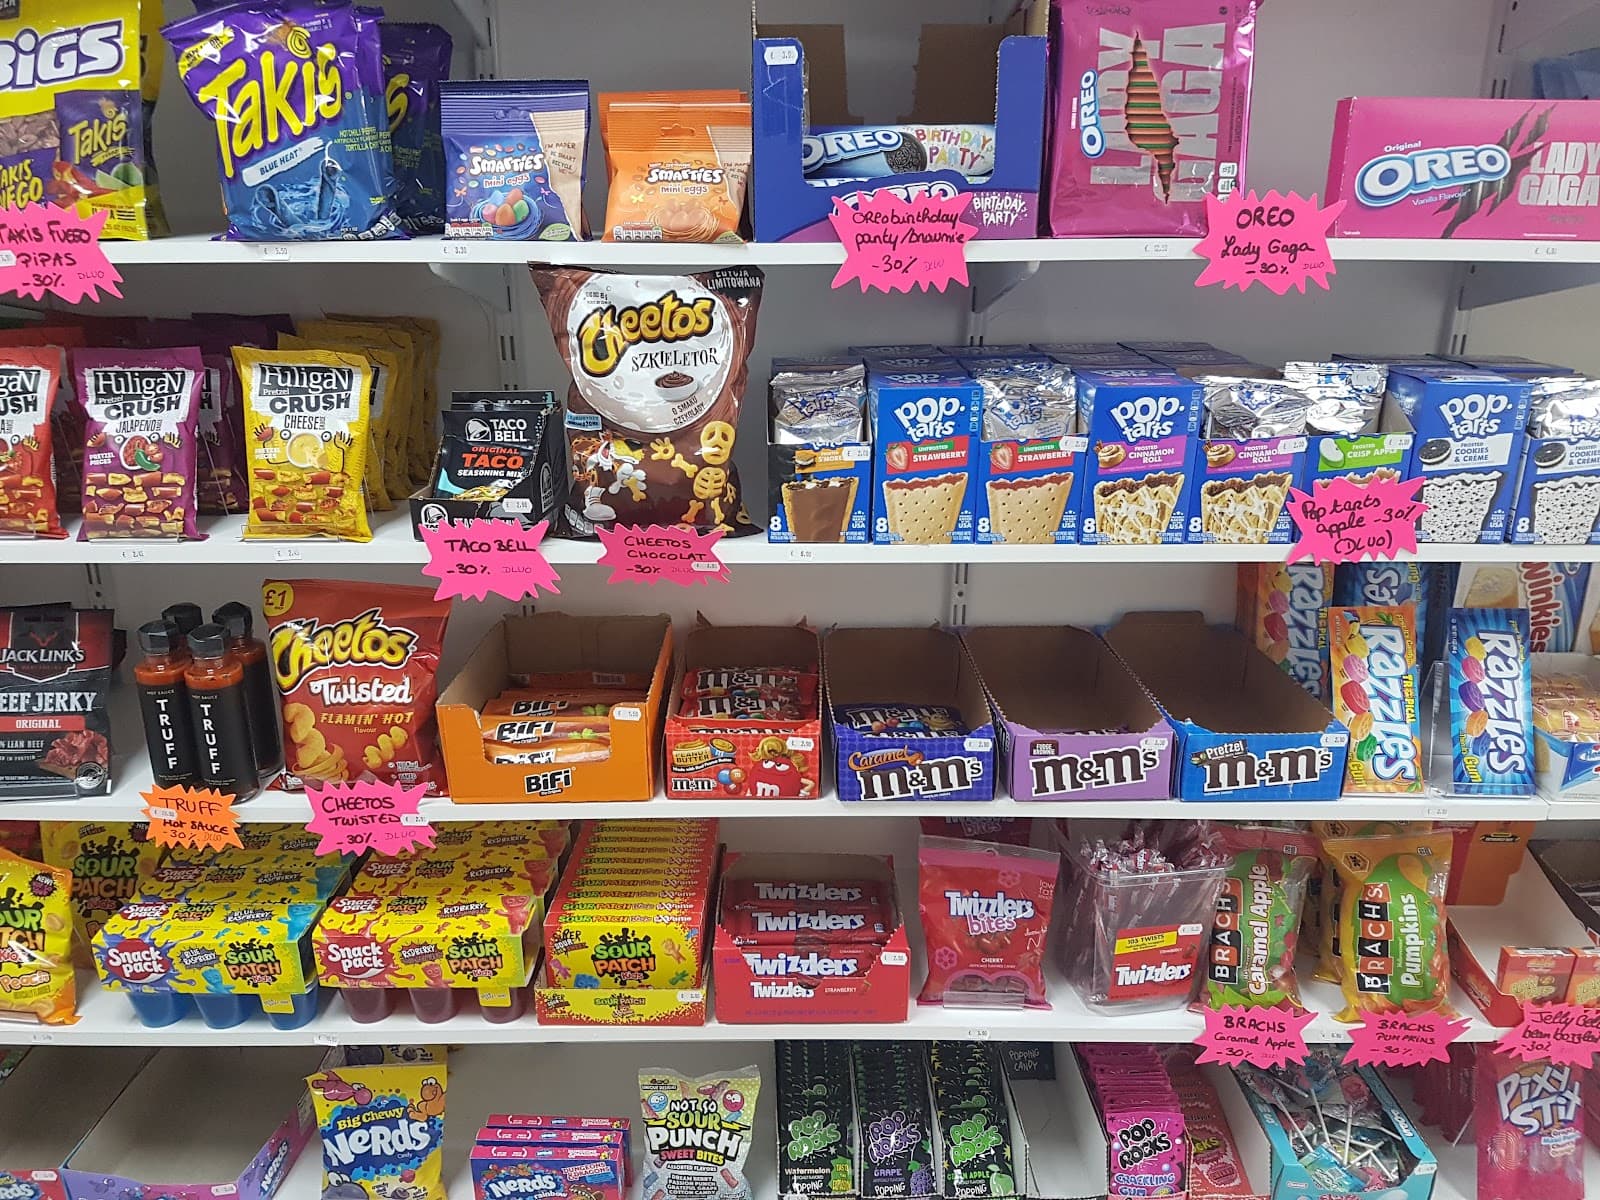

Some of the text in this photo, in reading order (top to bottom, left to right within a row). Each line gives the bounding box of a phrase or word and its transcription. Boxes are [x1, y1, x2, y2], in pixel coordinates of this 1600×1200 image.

[199, 38, 343, 179] Takis
[1080, 70, 1105, 157] OREO
[68, 112, 127, 165] Takis
[915, 128, 992, 151] BIRTHDAY
[1384, 141, 1422, 153] Original
[803, 130, 900, 170] OREO
[929, 146, 981, 169] PARTY
[1530, 142, 1600, 175] LADY
[260, 149, 299, 176] BLUE HEAT
[484, 173, 530, 188] mini eggs
[1363, 149, 1506, 197] OREO
[661, 184, 708, 195] mini eggs
[1519, 174, 1600, 207] GAGA
[973, 194, 1026, 212] BIRTHDAY
[982, 211, 1018, 227] PARTY
[1236, 206, 1296, 229] OREO
[1221, 235, 1316, 264] Lady Gaga
[707, 276, 762, 291] LIMITOWANA
[578, 291, 717, 377] Cheetos
[631, 347, 720, 373] SZKIELETOR
[263, 387, 290, 396] Pretzel
[104, 394, 182, 420] CRUSH
[269, 392, 351, 414] CRUSH
[284, 414, 320, 430] CHEESE
[490, 418, 527, 431] TACO
[907, 418, 956, 443] tarts
[494, 430, 527, 442] BELL
[1122, 419, 1175, 443] tarts
[471, 446, 520, 455] ORIGINAL
[912, 450, 967, 463] STRAWBERRY
[1017, 450, 1073, 463] STRAWBERRY
[1128, 448, 1175, 460] CINNAMON
[1134, 444, 1159, 452] FROSTED
[1244, 444, 1268, 453] FROSTED
[1346, 448, 1372, 459] CRISP
[1455, 447, 1490, 456] COOKIES
[461, 453, 525, 470] TACO
[1142, 456, 1163, 464] ROLL
[1252, 456, 1273, 464] ROLL
[1454, 455, 1461, 463] &
[457, 469, 524, 478] SEASONING MIX
[1301, 501, 1327, 521] Pop
[876, 517, 888, 532] 8
[1316, 512, 1367, 539] apple
[443, 538, 537, 553] TACO BELL
[624, 536, 692, 549] CHEETOS
[627, 550, 707, 561] CHOCOLAT
[264, 588, 288, 609] £1
[0, 648, 85, 665] JACK LINK'S
[271, 608, 415, 690] Cheetos
[309, 675, 414, 705] Twisted
[15, 718, 62, 730] ORIGINAL
[320, 711, 415, 724] FLAMIN' HOT
[156, 699, 179, 771] TRUFF
[496, 720, 555, 742] BiFi
[7, 739, 45, 749] LEAN BEEF
[200, 704, 221, 776] TRUFF
[675, 753, 710, 763] BUTTER
[848, 746, 911, 771] Caramel
[1206, 740, 1245, 760] Pretzel
[525, 768, 572, 795] BiFi
[158, 797, 224, 817] TRUFF
[321, 796, 396, 811] CHEETOS
[74, 855, 137, 877] SOUR
[753, 883, 863, 901] Twizzlers
[336, 897, 381, 906] Snack
[443, 902, 485, 914] REDBERRY
[945, 891, 1035, 919] Twizzlers
[227, 911, 272, 924] RASPBERRY
[751, 910, 866, 933] Twizzlers
[967, 913, 1017, 936] bites
[1248, 864, 1270, 996] Caramel Apple
[1401, 892, 1423, 987] Pumpkins
[109, 948, 165, 967] Snack
[226, 949, 276, 964] SOUR
[327, 943, 383, 962] Snack
[401, 945, 436, 958] REDBERRY
[449, 943, 499, 958] SOUR
[594, 942, 650, 959] SOUR
[123, 961, 166, 978] pack
[228, 963, 282, 980] PATCH
[341, 956, 385, 972] pack
[450, 956, 503, 972] PATCH
[594, 958, 655, 974] PATCH
[742, 952, 859, 977] Twizzlers
[1115, 961, 1192, 986] Twizzlers
[824, 986, 857, 994] STRAWBERRY
[620, 997, 646, 1006] PATCH
[1223, 1015, 1287, 1033] BRACHS
[1377, 1019, 1436, 1033] BRACHS
[1214, 1032, 1296, 1049] Caramel Apple
[1009, 1048, 1040, 1059] POPPING
[1013, 1061, 1039, 1072] CANDY
[671, 1100, 717, 1114] NOT SO
[337, 1107, 405, 1131] Big Chewy
[666, 1110, 721, 1131] SOUR
[789, 1110, 827, 1140] POP
[869, 1110, 906, 1141] POP
[950, 1114, 987, 1145] POP
[1118, 1118, 1157, 1149] POP
[646, 1126, 743, 1158] PUNCH
[949, 1125, 1003, 1167] ROCKS
[661, 1150, 725, 1165] SWEET BITES
[1118, 1133, 1172, 1170] ROCKS
[561, 1162, 607, 1174] DUNGEONS
[785, 1167, 831, 1175] Watermelon
[873, 1168, 903, 1177] GRAPE
[969, 1169, 991, 1180] APPLE
[1114, 1173, 1176, 1185] CRACKLING
[534, 1191, 568, 1200] rainbow
[874, 1183, 906, 1197] POPPING
[956, 1183, 988, 1196] POPPING
